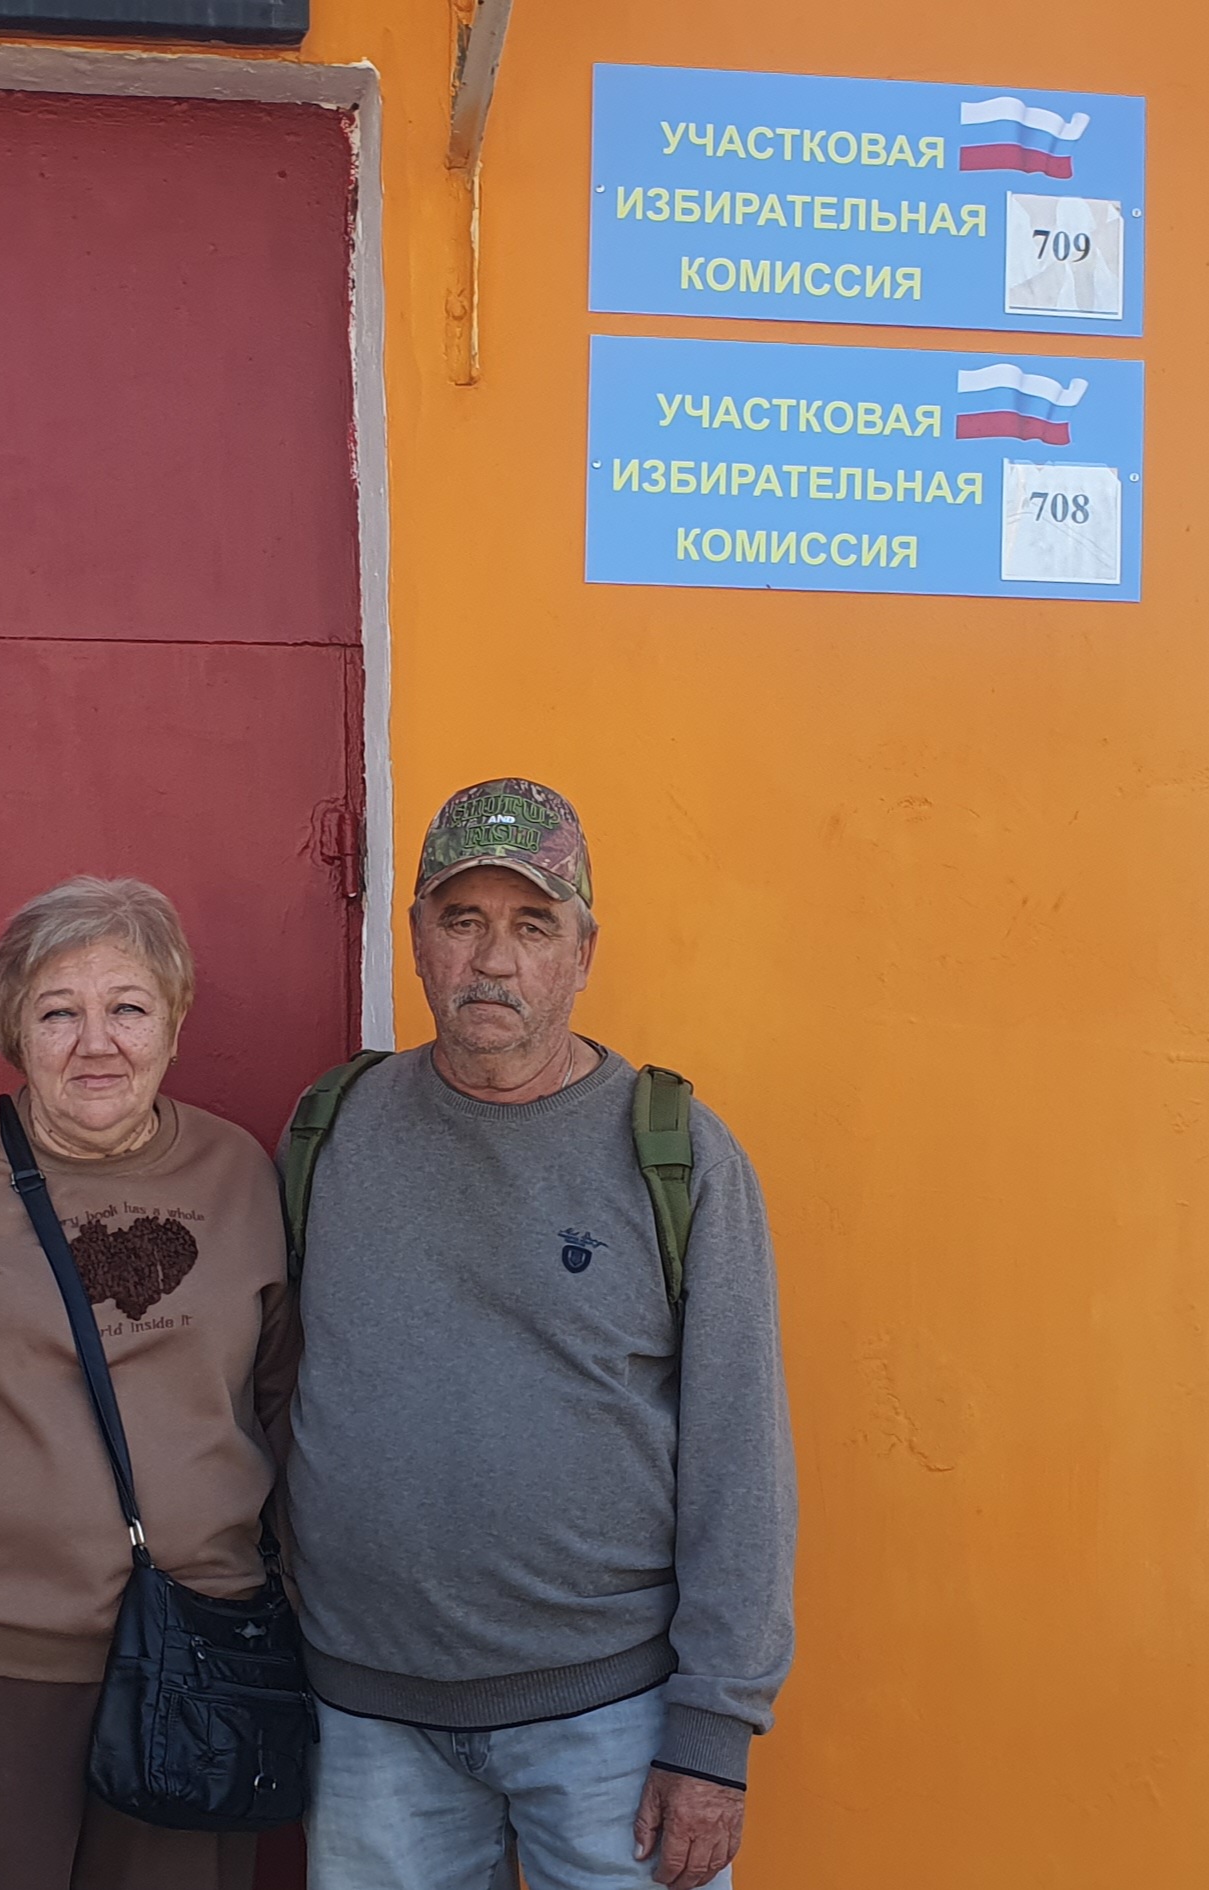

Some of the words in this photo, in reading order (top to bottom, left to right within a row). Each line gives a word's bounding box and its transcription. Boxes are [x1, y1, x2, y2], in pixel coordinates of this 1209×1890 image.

[660, 121, 945, 169] УЧАСТКОВАЯ
[615, 186, 986, 237] ИЗБИРАТЕЛЬНАЯ
[1032, 229, 1091, 263] 709
[680, 256, 922, 301] КОМИССИЯ
[656, 393, 941, 438] УЧАСТКОВАЯ
[612, 458, 983, 505] ИЗБИРАТЕЛЬНАЯ
[1029, 491, 1090, 525] 708
[676, 527, 918, 568] КОМИССИЯ
[488, 814, 515, 824] AND
[463, 823, 541, 853] FISH!
[85, 1204, 118, 1221] book
[124, 1201, 146, 1214] has
[153, 1207, 160, 1216] a
[167, 1207, 205, 1221] whole
[100, 1322, 123, 1337] rld
[131, 1316, 173, 1333] inside
[181, 1314, 192, 1326] it
